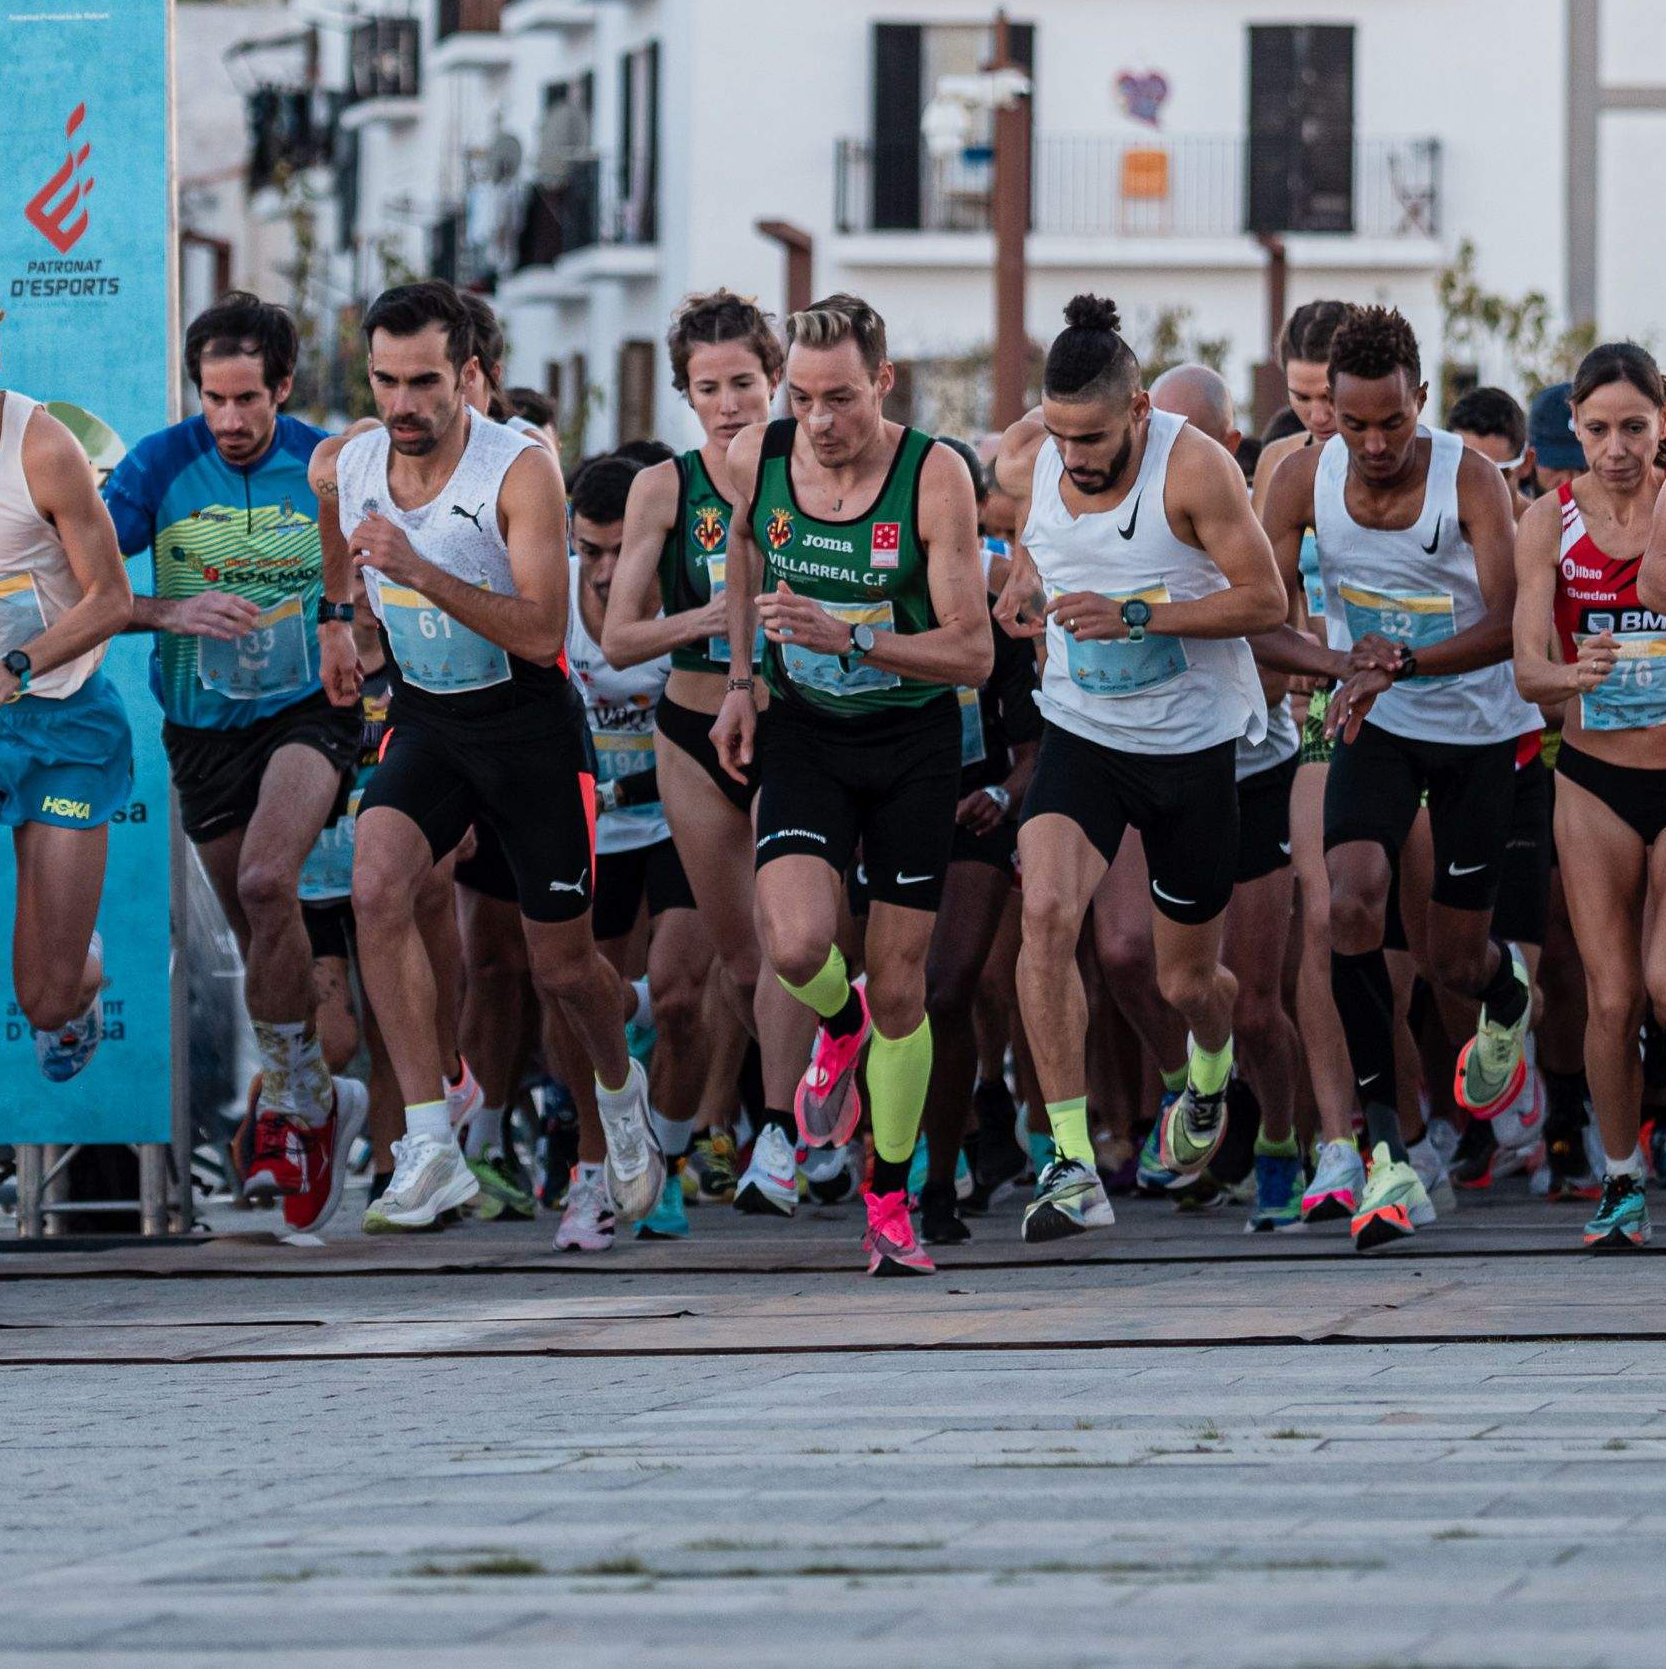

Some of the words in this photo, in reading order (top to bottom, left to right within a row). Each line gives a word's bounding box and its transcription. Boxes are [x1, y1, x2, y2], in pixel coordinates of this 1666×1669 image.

[27, 259, 102, 273] PATRONAT
[11, 277, 119, 297] D'ESPORTS
[802, 534, 854, 553] Joma
[768, 551, 860, 583] VILLARREAL
[418, 610, 452, 639] 61
[41, 795, 91, 820] HOKA
